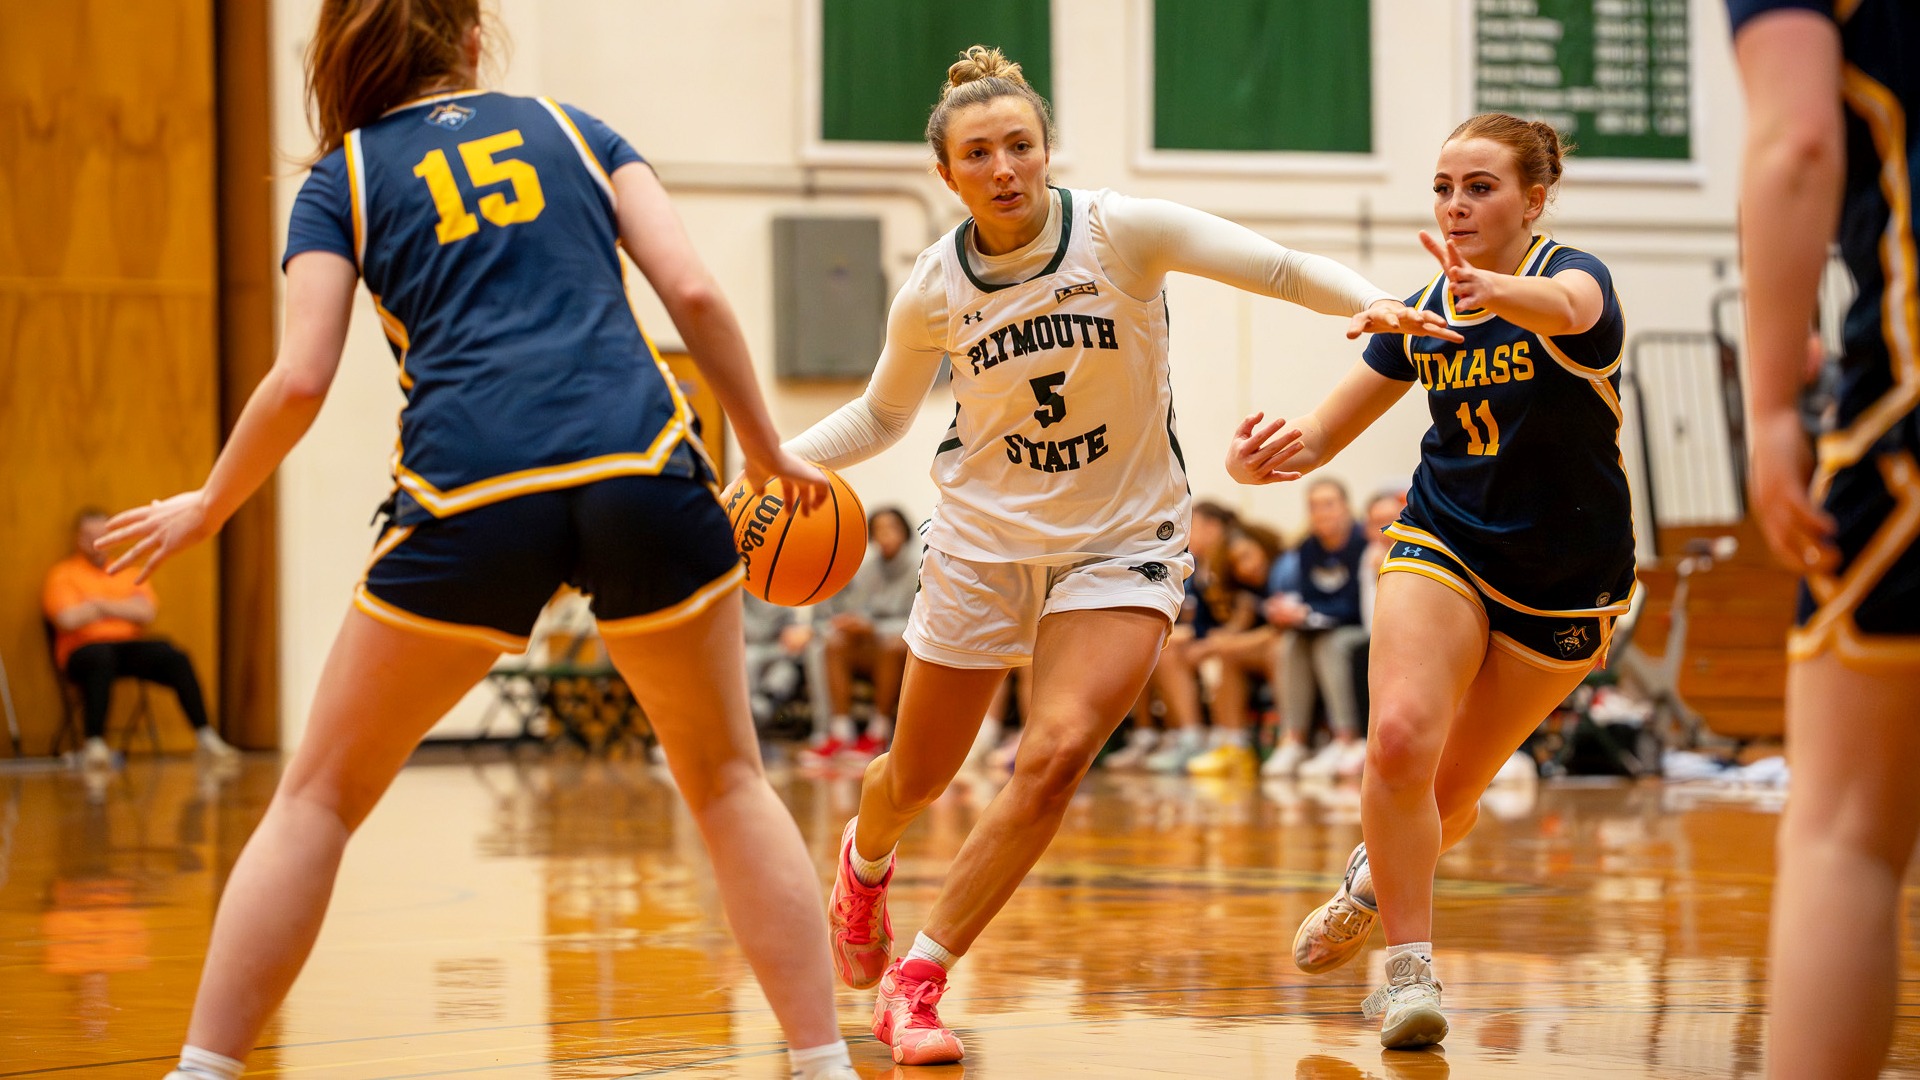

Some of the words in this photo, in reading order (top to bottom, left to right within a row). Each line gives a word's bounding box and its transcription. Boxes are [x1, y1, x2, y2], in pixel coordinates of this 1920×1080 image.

[412, 129, 546, 246] 15
[1056, 283, 1096, 301] LEC
[966, 313, 1119, 376] PLYMOUTH
[1413, 340, 1535, 392] UMASS
[1029, 371, 1067, 429] 5
[1455, 399, 1500, 456] 11
[1003, 423, 1109, 474] STATE
[740, 494, 784, 582] Wilso
